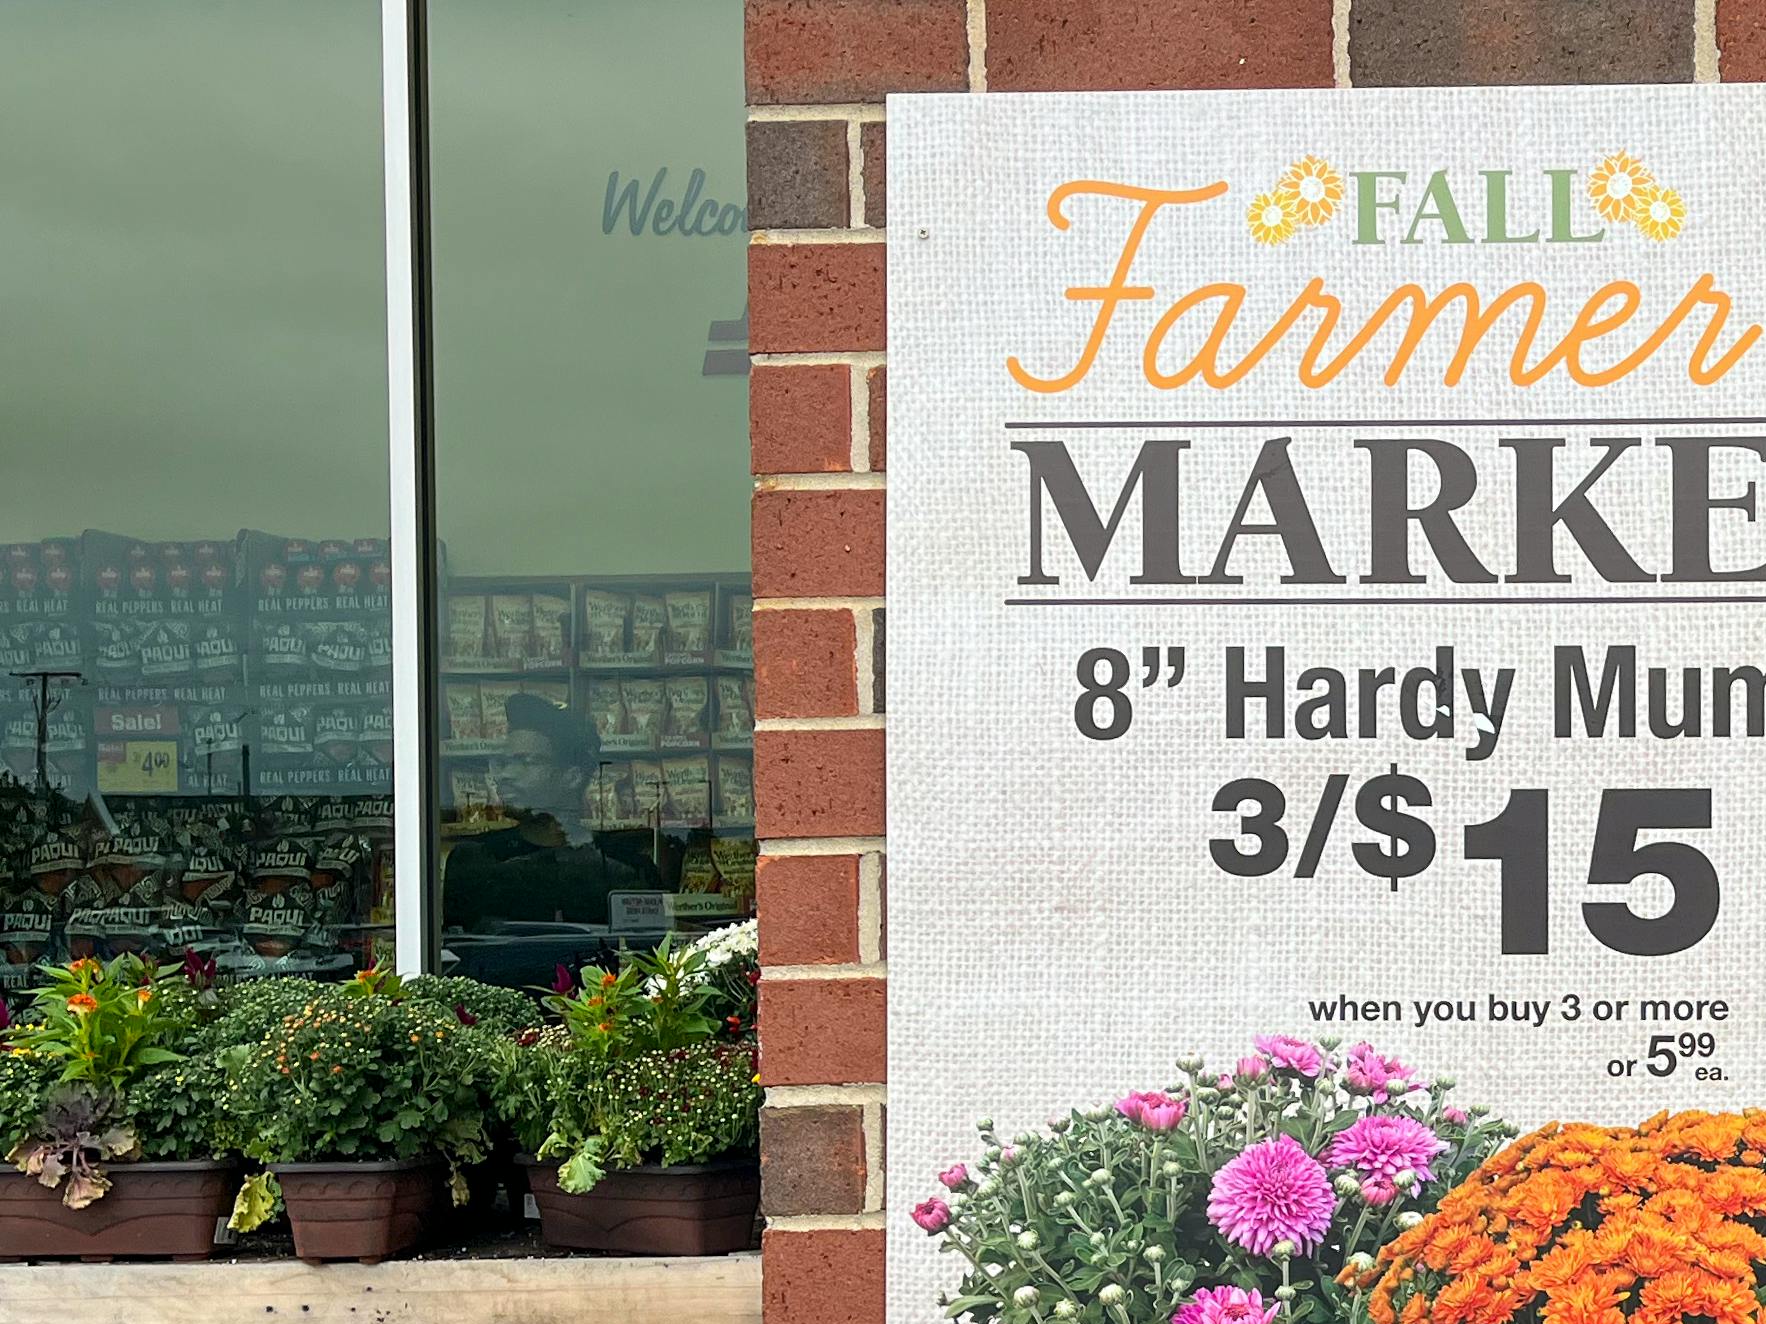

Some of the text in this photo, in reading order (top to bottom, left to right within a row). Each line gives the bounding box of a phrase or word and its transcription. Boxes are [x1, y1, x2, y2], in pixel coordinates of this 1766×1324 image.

[602, 166, 748, 236] Welco
[1350, 168, 1606, 247] FALL
[141, 644, 190, 664] PAQUI
[664, 657, 705, 665] POPCORN
[1226, 645, 1515, 761] Hardy
[111, 713, 162, 731] Sale!
[660, 740, 700, 748] POPCORN
[32, 842, 80, 863] PAQUI
[704, 901, 738, 911] Original
[3, 913, 52, 931] PAQUI
[249, 908, 305, 925] PAQUI
[1309, 994, 1729, 1027] when you buy 3 or more
[1607, 1058, 1638, 1077] or
[1695, 1064, 1729, 1081] ea.
